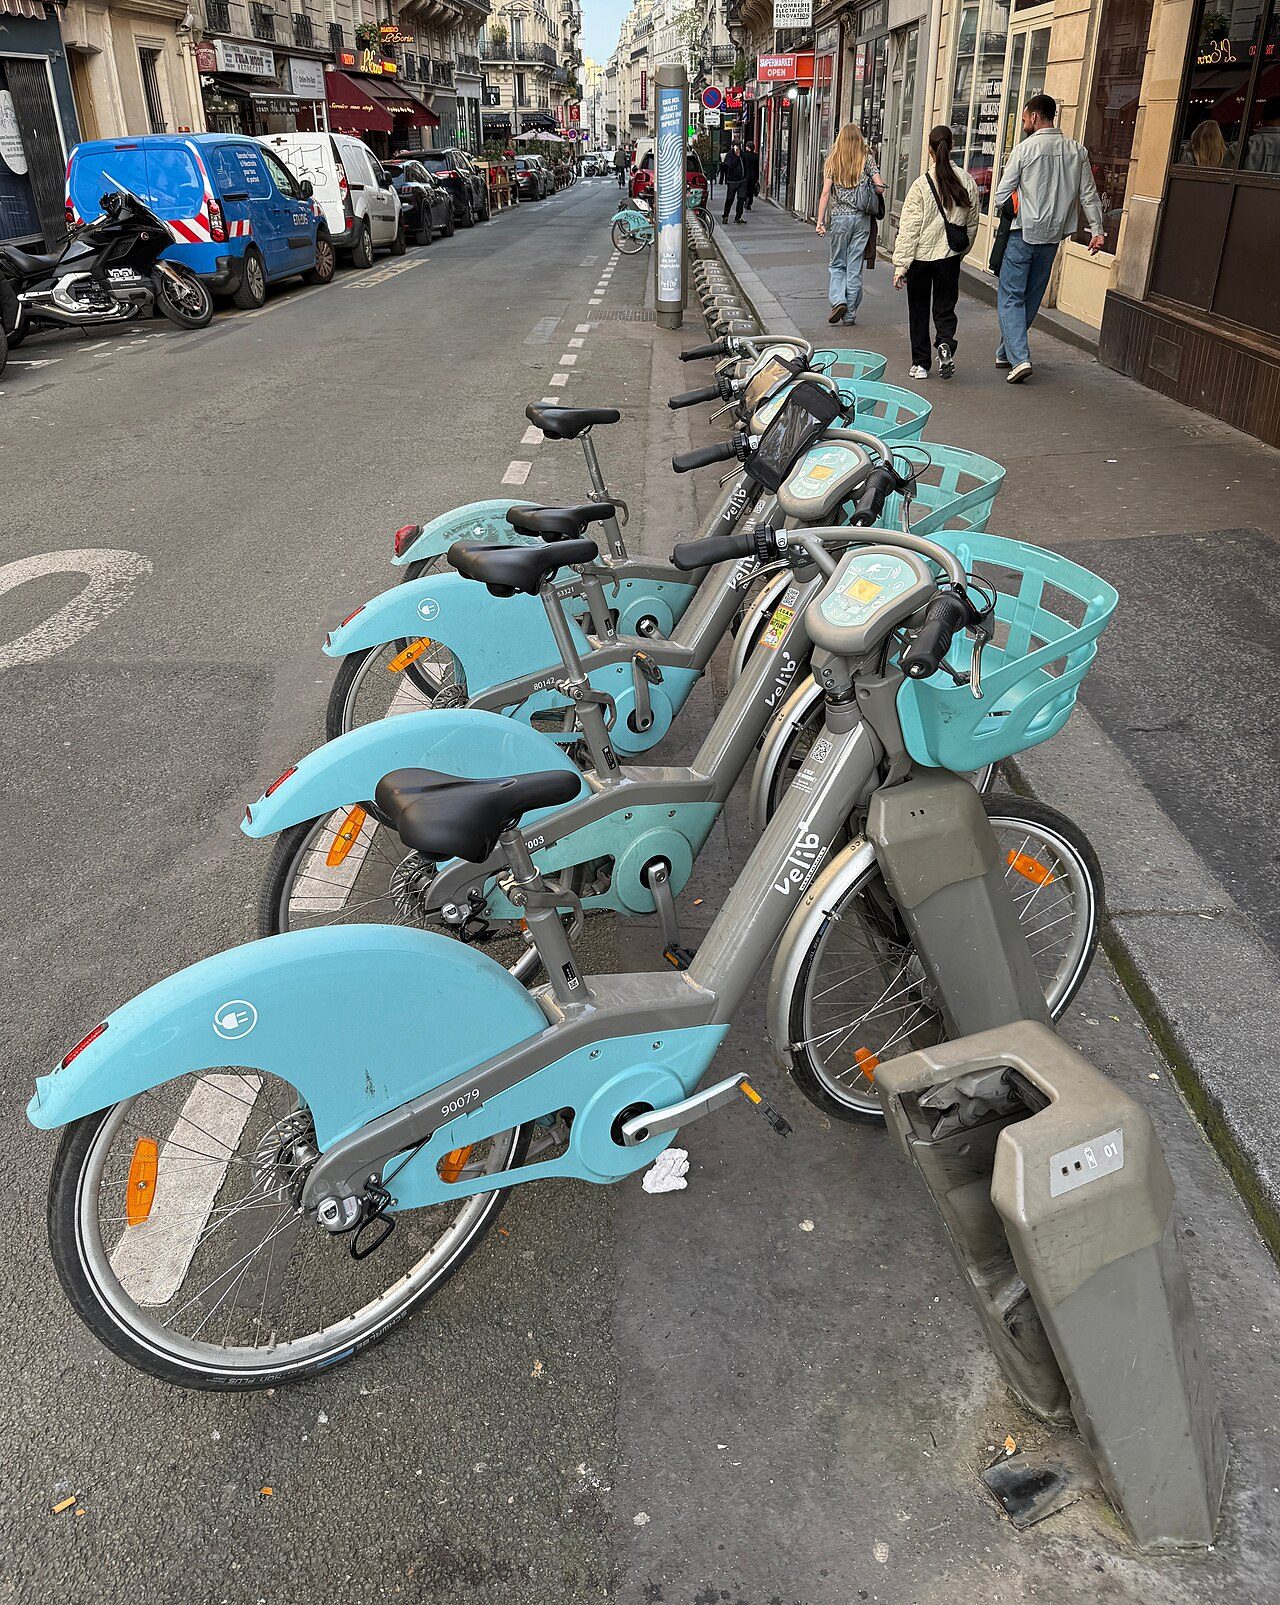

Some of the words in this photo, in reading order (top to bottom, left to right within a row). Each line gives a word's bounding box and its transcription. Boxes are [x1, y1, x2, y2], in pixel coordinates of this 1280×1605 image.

[759, 58, 794, 68] SUPERMARKET
[767, 68, 787, 77] OPEN
[533, 677, 555, 691] 80142
[441, 1088, 480, 1117] 90079
[1103, 1142, 1119, 1158] 01
